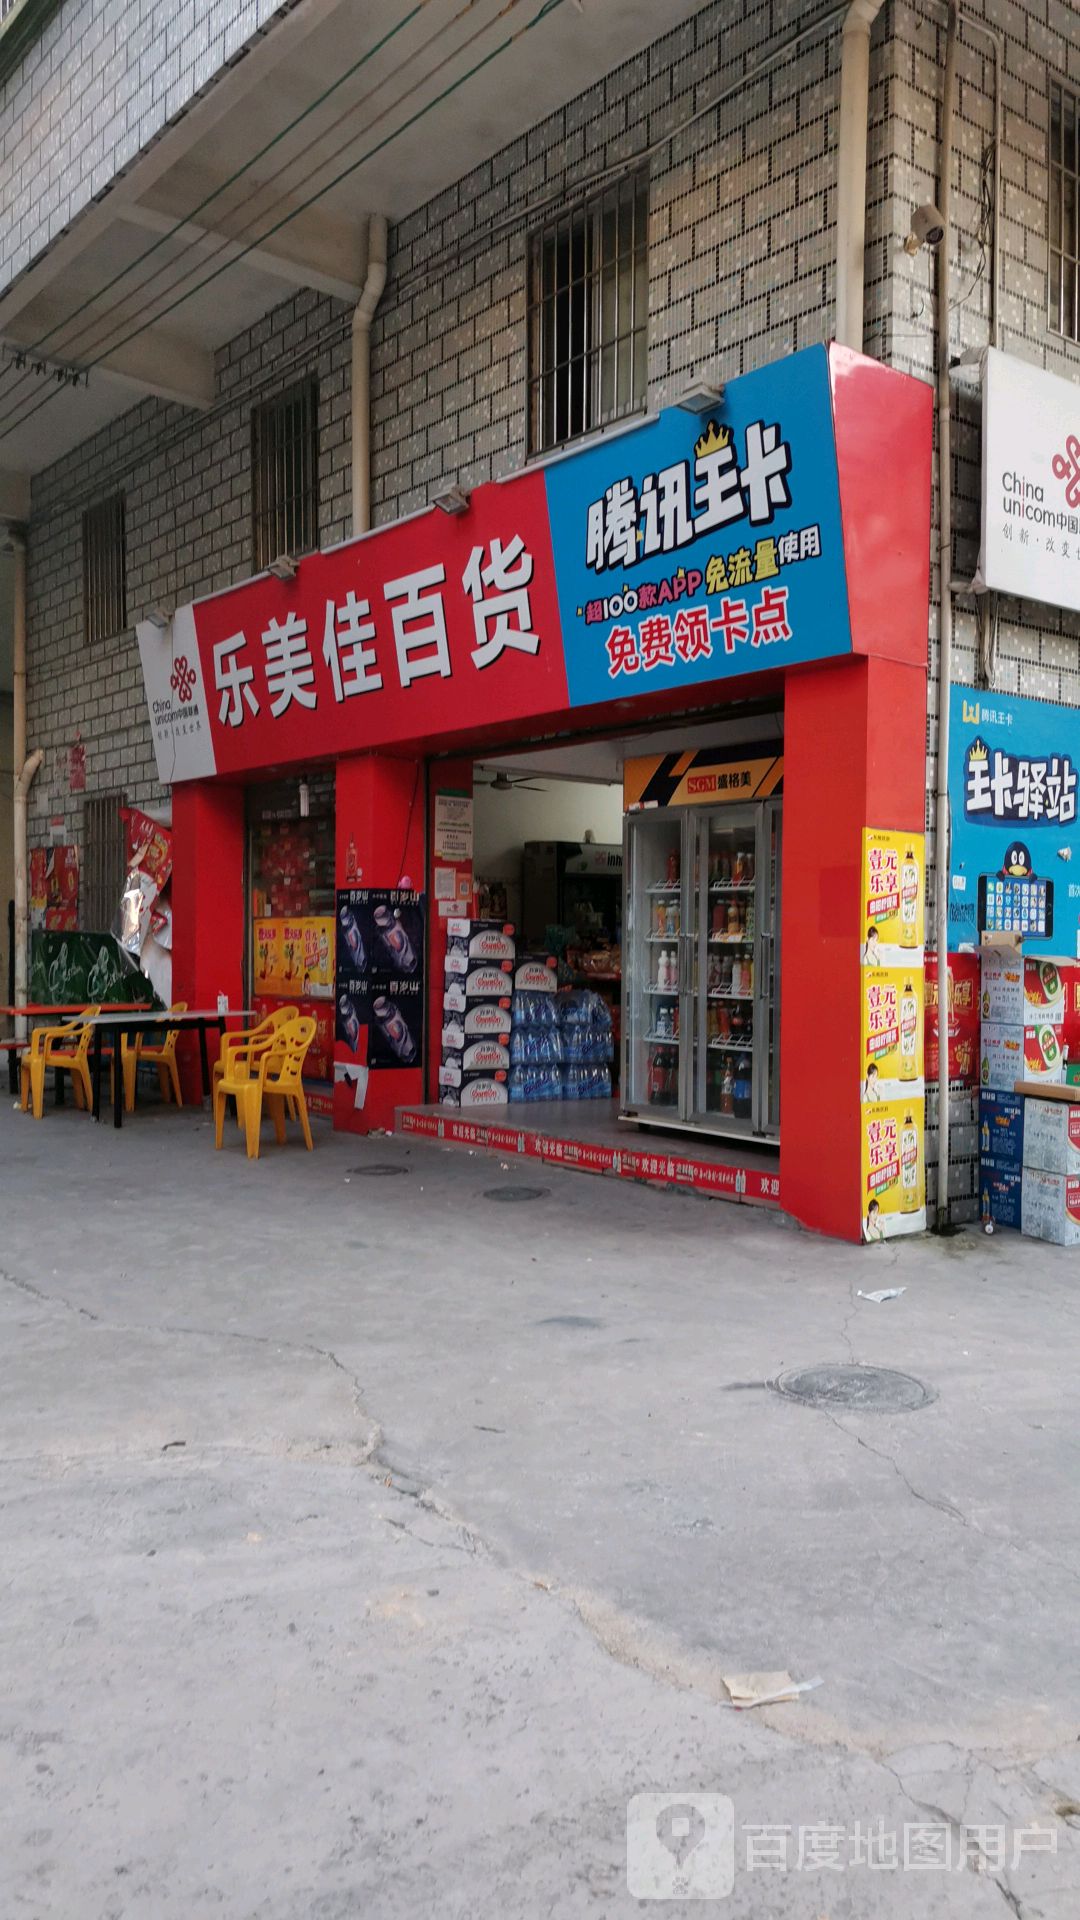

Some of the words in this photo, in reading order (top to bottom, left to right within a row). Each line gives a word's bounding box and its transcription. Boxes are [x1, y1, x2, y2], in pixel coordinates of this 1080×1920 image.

[587, 421, 792, 571] 腾讯王卡
[1002, 472, 1044, 502] China
[213, 533, 541, 728] 乐美佳百货
[606, 586, 792, 677] 免费领卡点
[981, 708, 1013, 726] 腾讯王卡
[688, 775, 716, 794] SGM
[718, 771, 752, 789] 盛格美
[967, 751, 1077, 823] 王卡驿站
[641, 1158, 674, 1177] 欢迎光临
[760, 1177, 780, 1195] 欢迎
